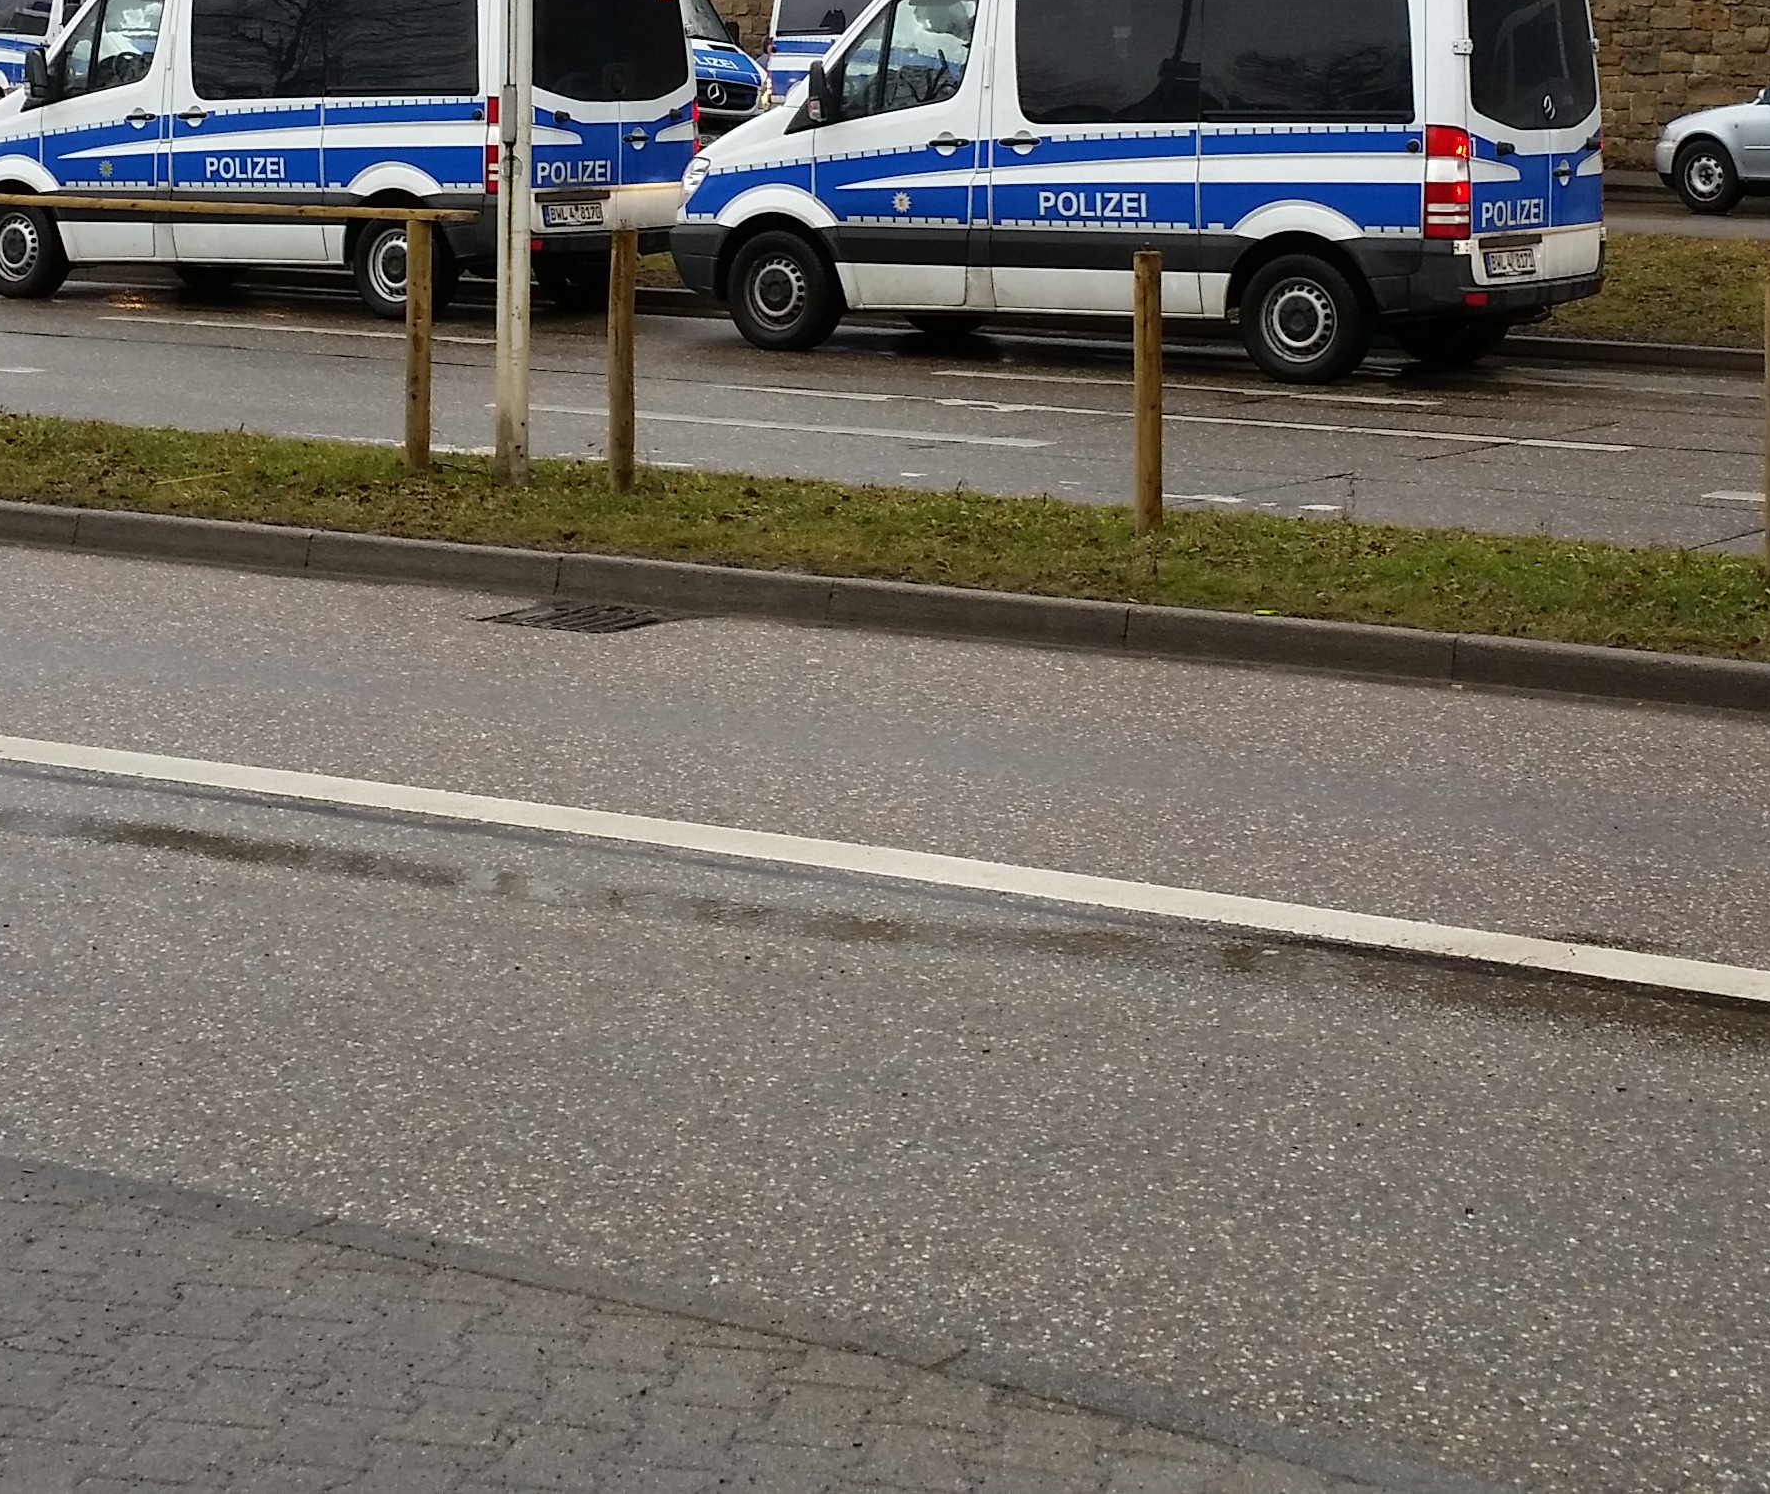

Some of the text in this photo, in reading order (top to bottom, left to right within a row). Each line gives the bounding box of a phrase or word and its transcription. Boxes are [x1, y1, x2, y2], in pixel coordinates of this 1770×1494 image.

[693, 55, 739, 70] LIZEI
[205, 157, 285, 179] POLIZEI
[536, 159, 611, 185] POLIZEI
[1038, 191, 1147, 218] POLIZEI
[1481, 198, 1544, 228] POLIZEI
